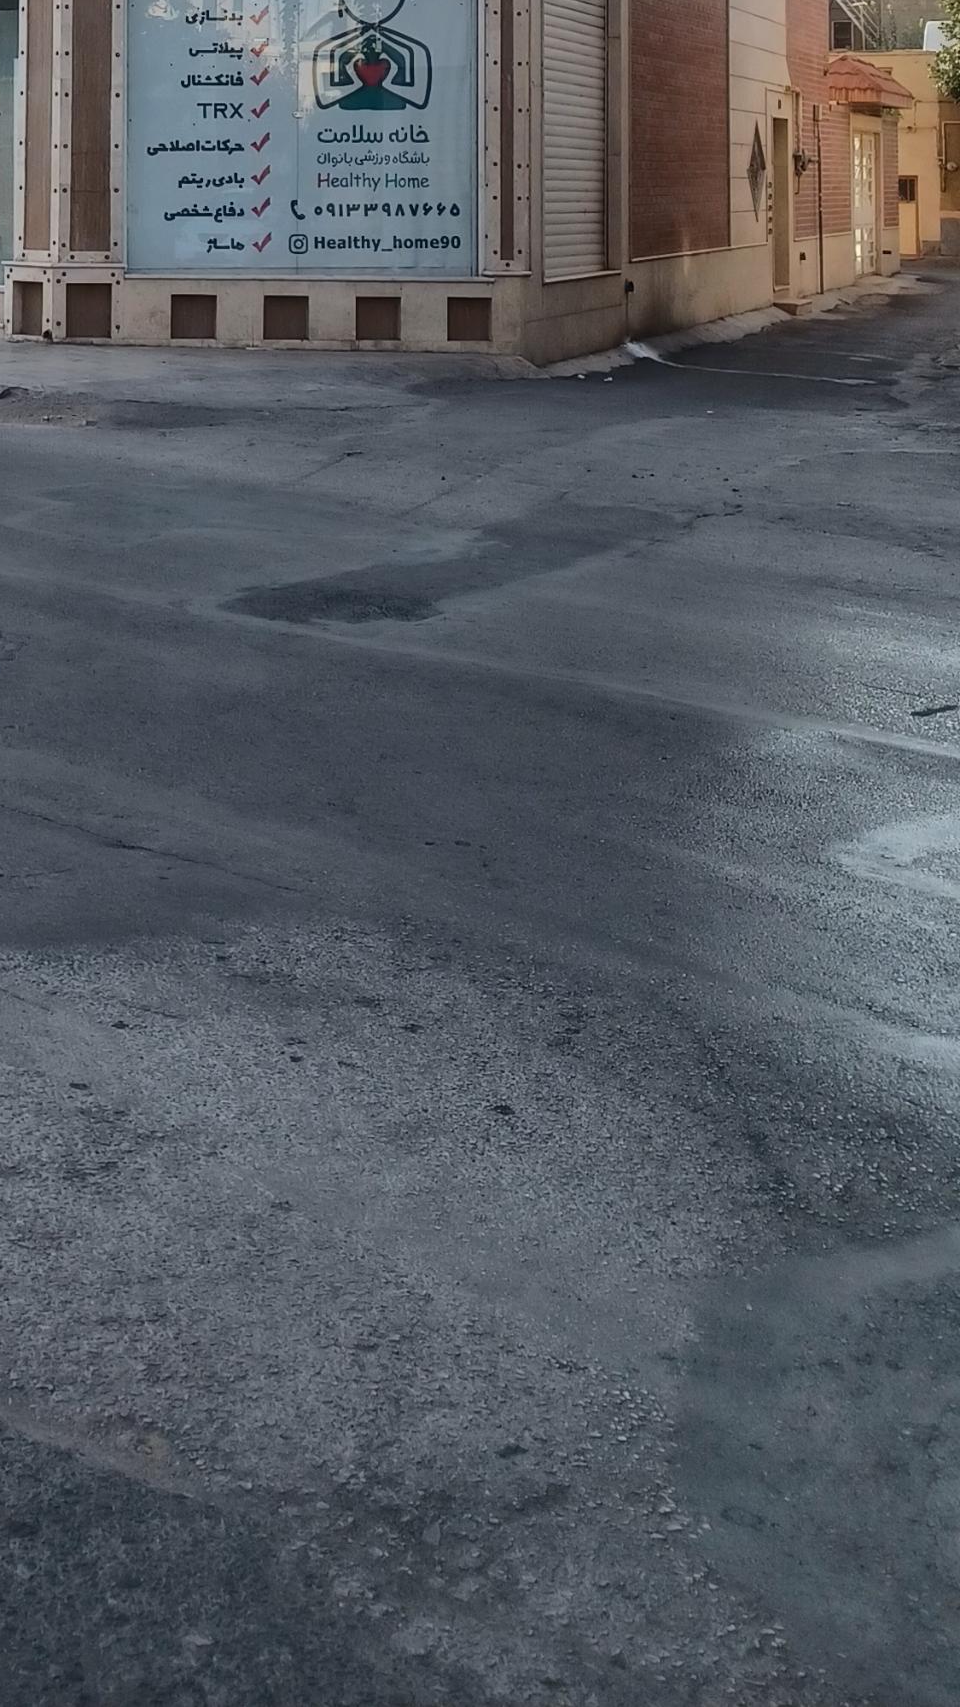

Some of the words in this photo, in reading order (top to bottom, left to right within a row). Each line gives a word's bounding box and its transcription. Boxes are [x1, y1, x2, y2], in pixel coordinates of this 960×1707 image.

[180, 71, 245, 89] فانکشنال
[196, 102, 244, 119] TRX
[316, 124, 384, 144] سلامت
[388, 124, 431, 143] خانه
[146, 139, 200, 156] اصلاحی
[200, 138, 245, 156] حرکات
[316, 151, 353, 168] بانوان
[354, 150, 391, 166] ورزشی
[392, 150, 431, 167] باشگاه
[177, 172, 212, 189] ریتم
[212, 172, 245, 189] بادی
[316, 172, 381, 193] Healthy
[384, 172, 431, 189] Home
[163, 203, 214, 222] شخصی
[213, 201, 245, 224] دفاع
[206, 237, 245, 254] ماساژ
[313, 235, 462, 253] Healthy_home90
